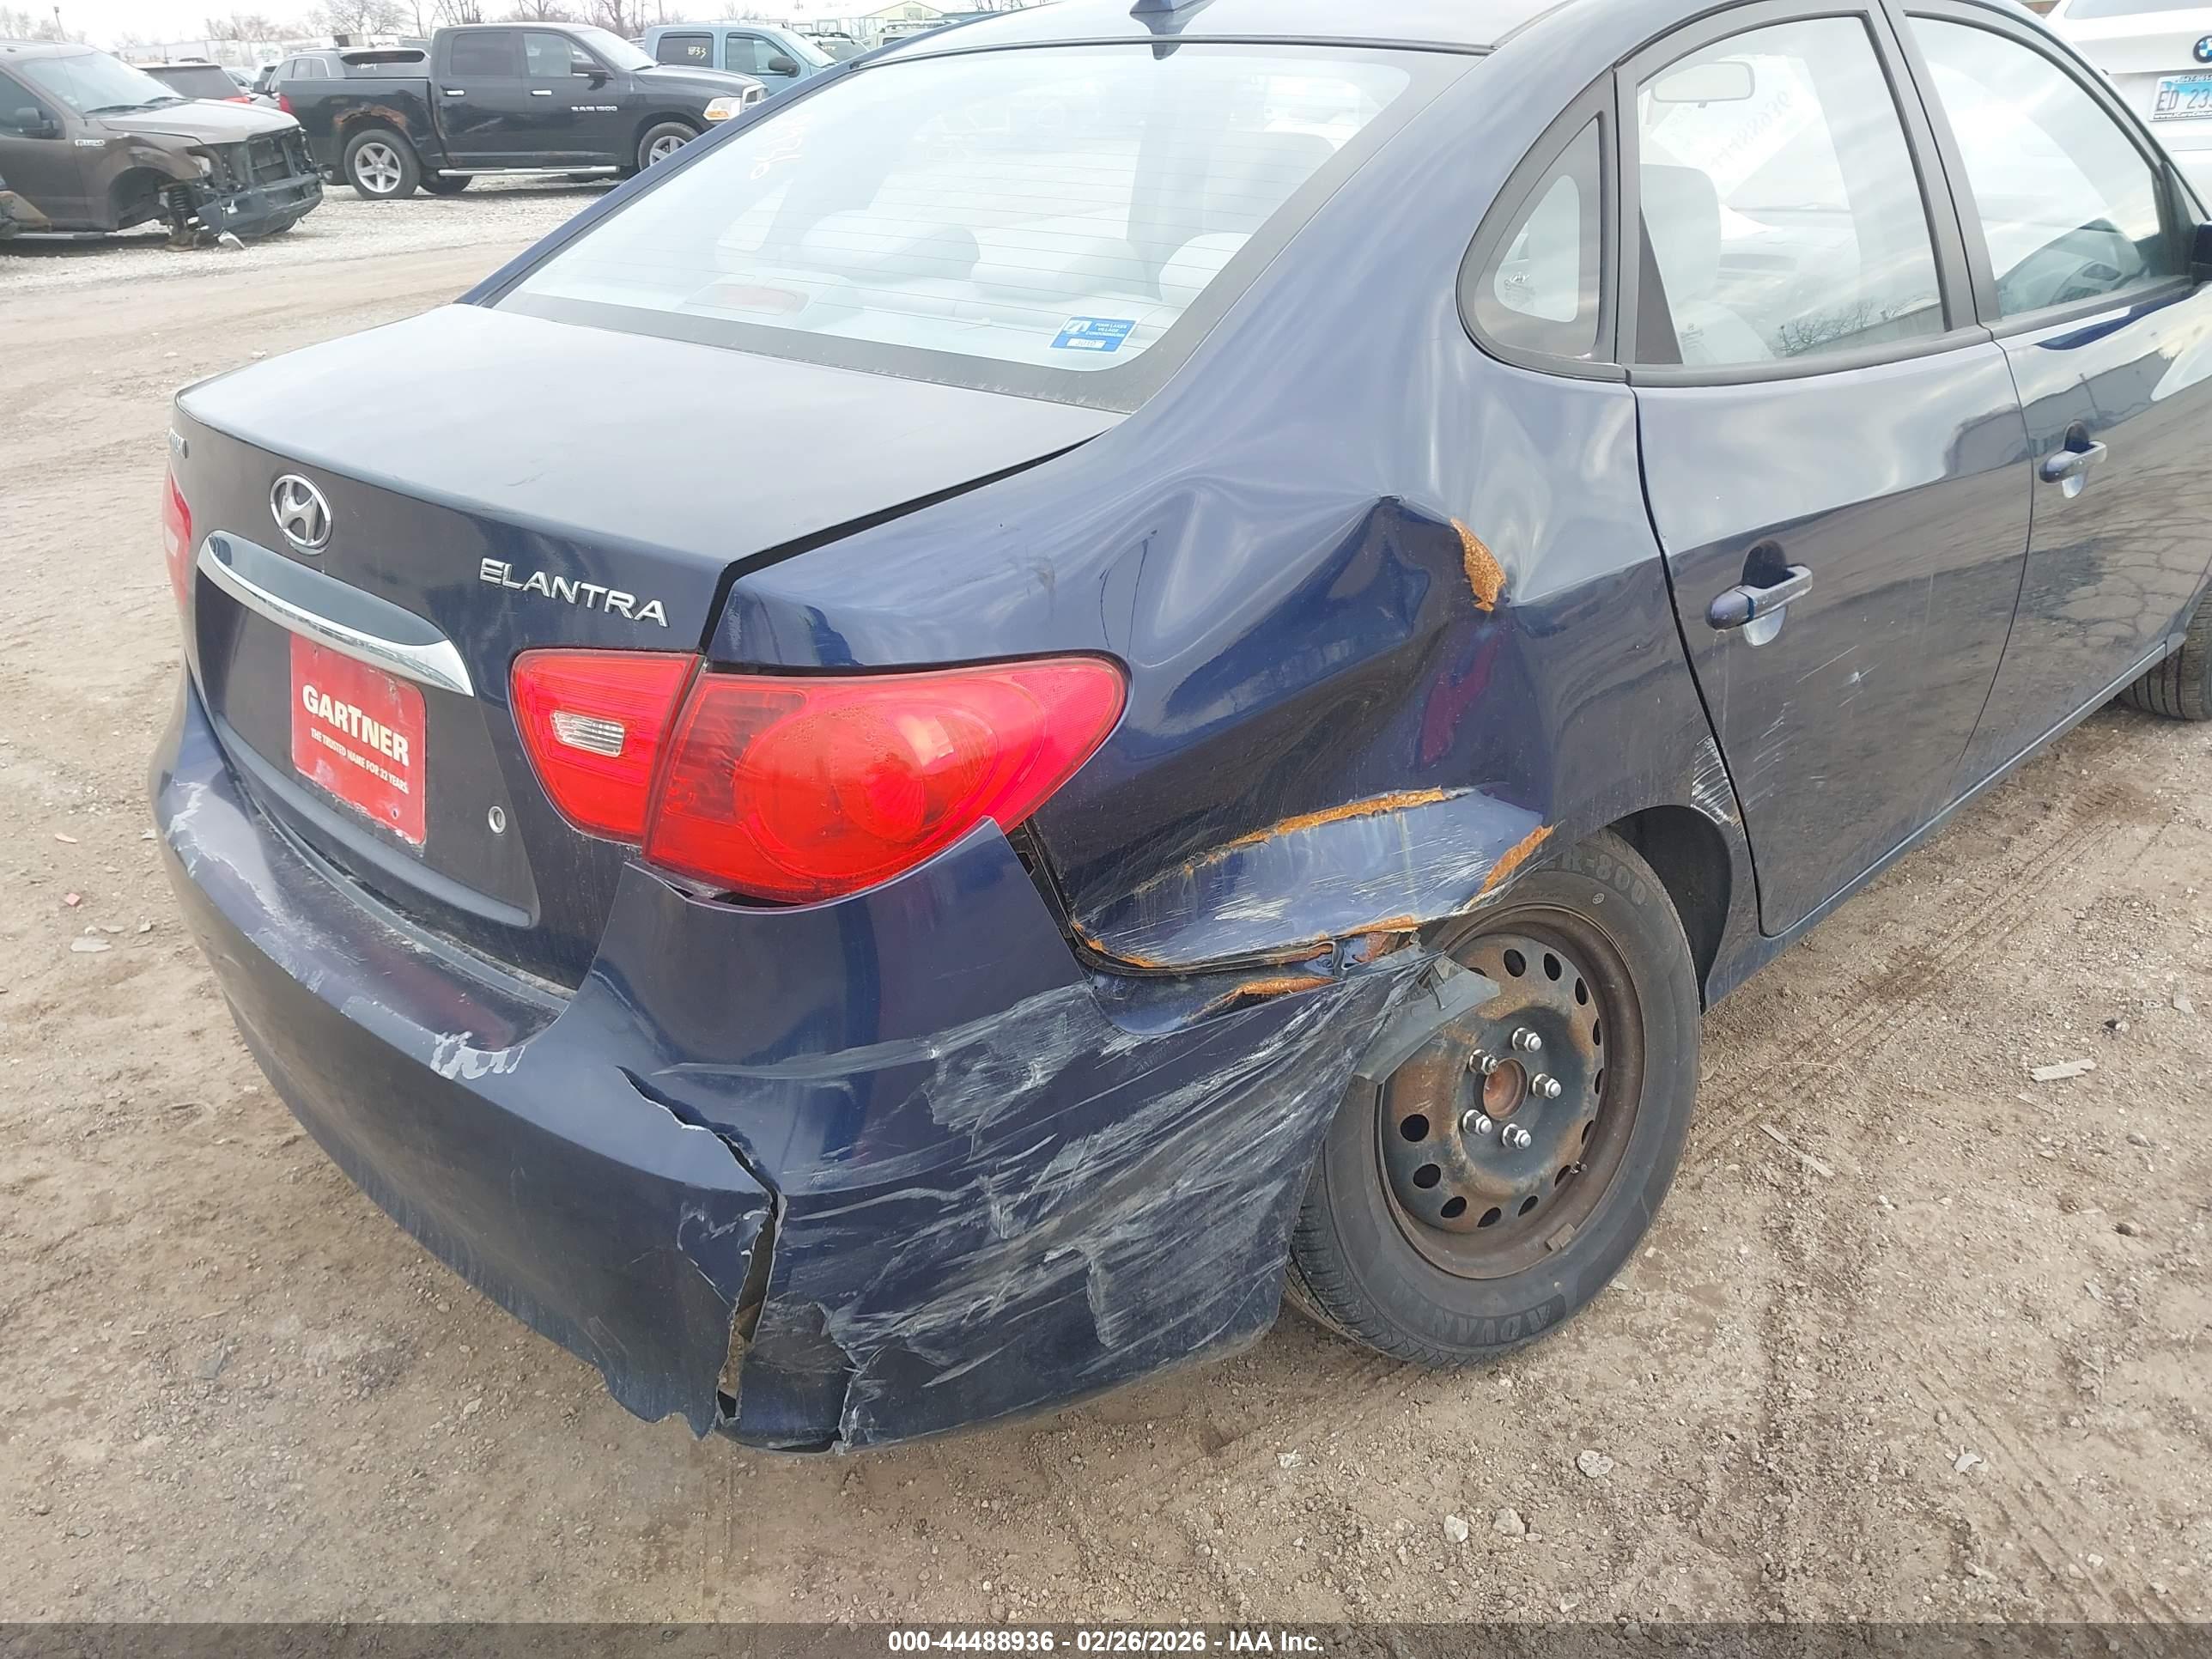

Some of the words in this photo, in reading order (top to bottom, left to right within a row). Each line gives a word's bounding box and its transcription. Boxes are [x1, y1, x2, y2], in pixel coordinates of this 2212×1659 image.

[2156, 89, 2180, 111] ED
[478, 556, 670, 629] ELANTRA
[302, 684, 410, 768] GARTNER
[310, 727, 324, 743] THE
[322, 733, 346, 757] TRUSTED
[346, 747, 367, 769] NAME
[365, 759, 380, 777] FOR
